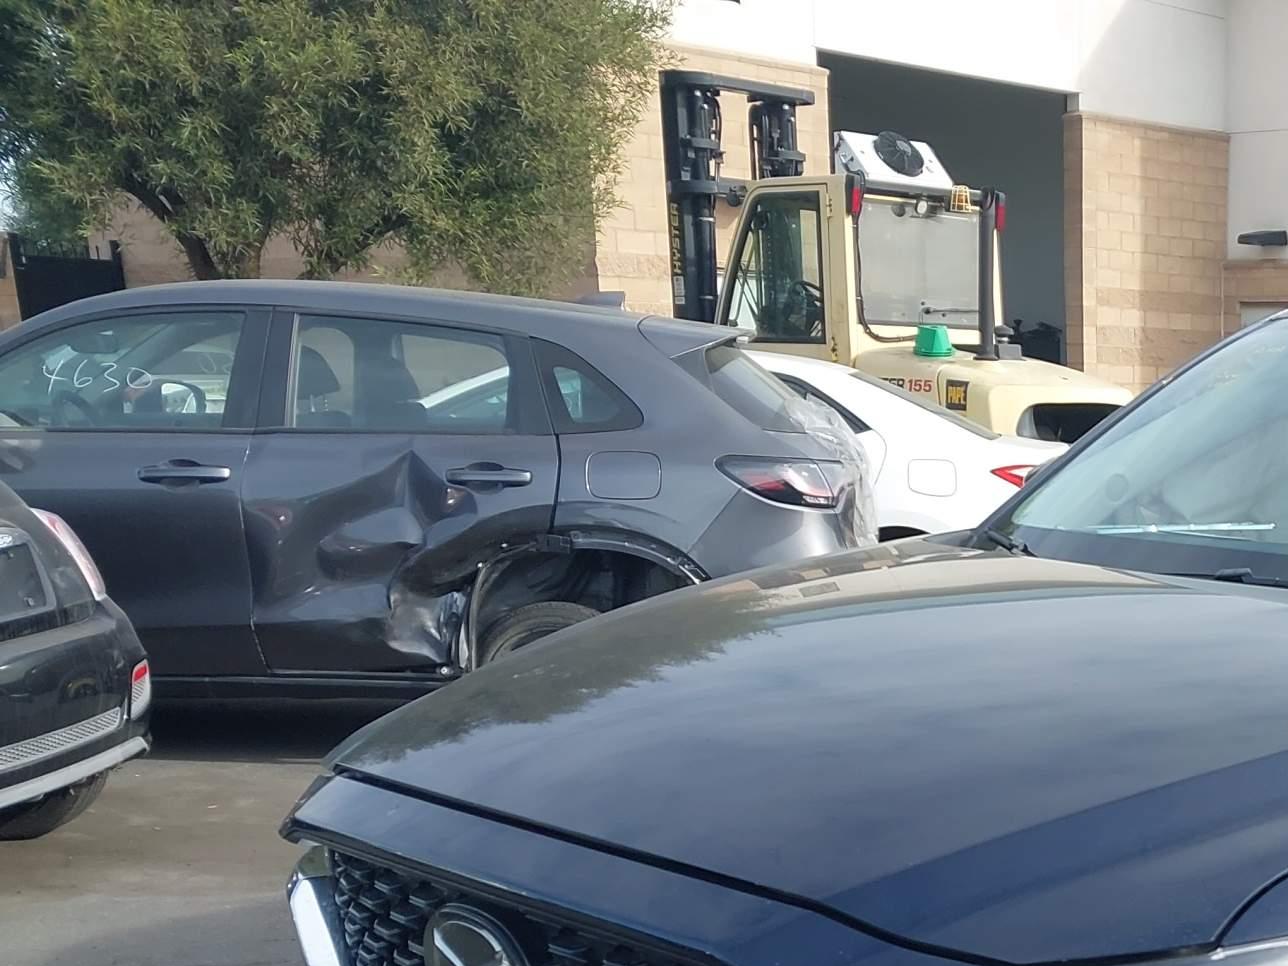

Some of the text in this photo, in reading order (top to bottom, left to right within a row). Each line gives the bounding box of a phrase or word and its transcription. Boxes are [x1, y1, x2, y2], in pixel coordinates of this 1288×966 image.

[670, 202, 682, 274] HYSTER
[42, 359, 154, 396] 4630
[907, 378, 933, 393] 155
